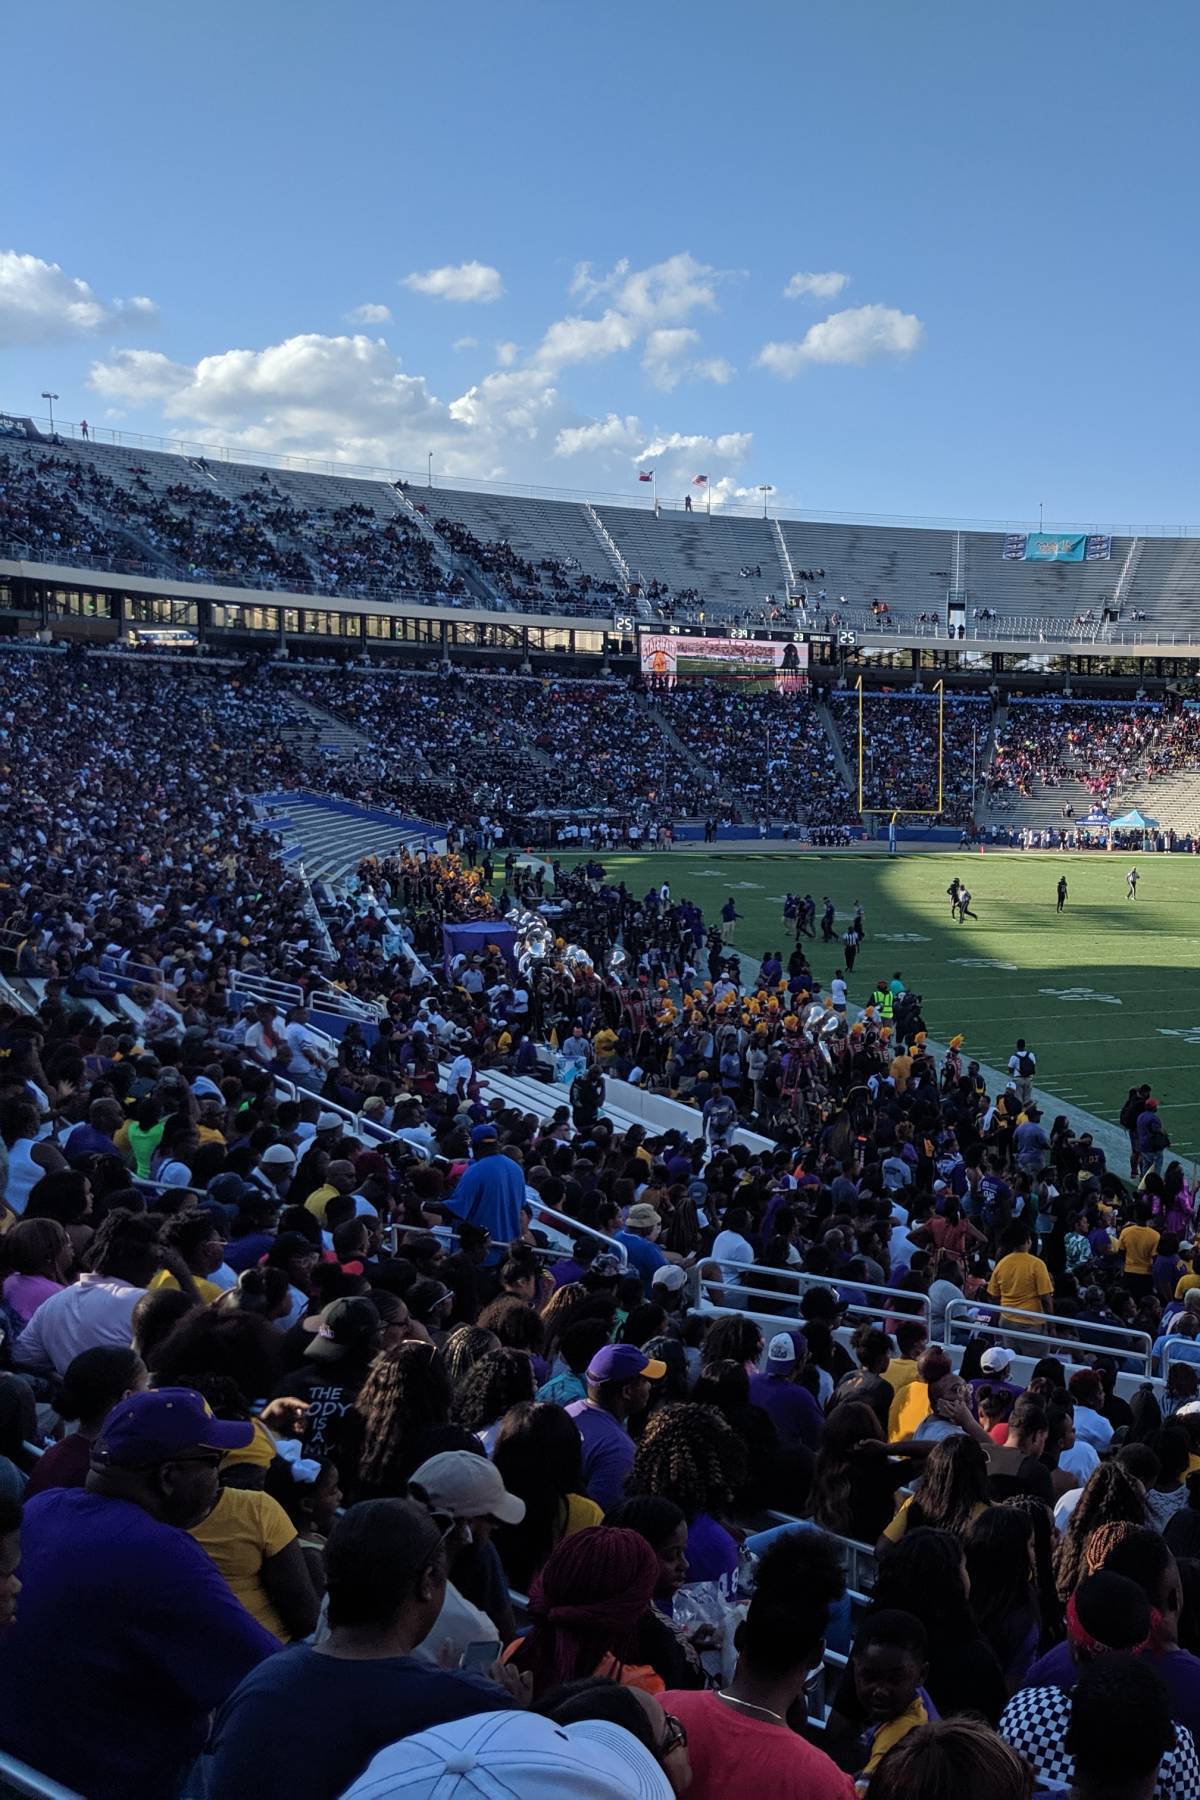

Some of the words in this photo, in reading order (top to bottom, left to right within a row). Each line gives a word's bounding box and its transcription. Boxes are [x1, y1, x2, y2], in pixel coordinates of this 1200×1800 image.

[617, 617, 632, 630] 25
[669, 625, 680, 634] 24
[793, 633, 804, 641] 23
[840, 632, 855, 643] 25
[309, 1386, 344, 1400] THE
[304, 1401, 354, 1417] ODY
[312, 1417, 328, 1430] IS
[311, 1430, 325, 1443] A
